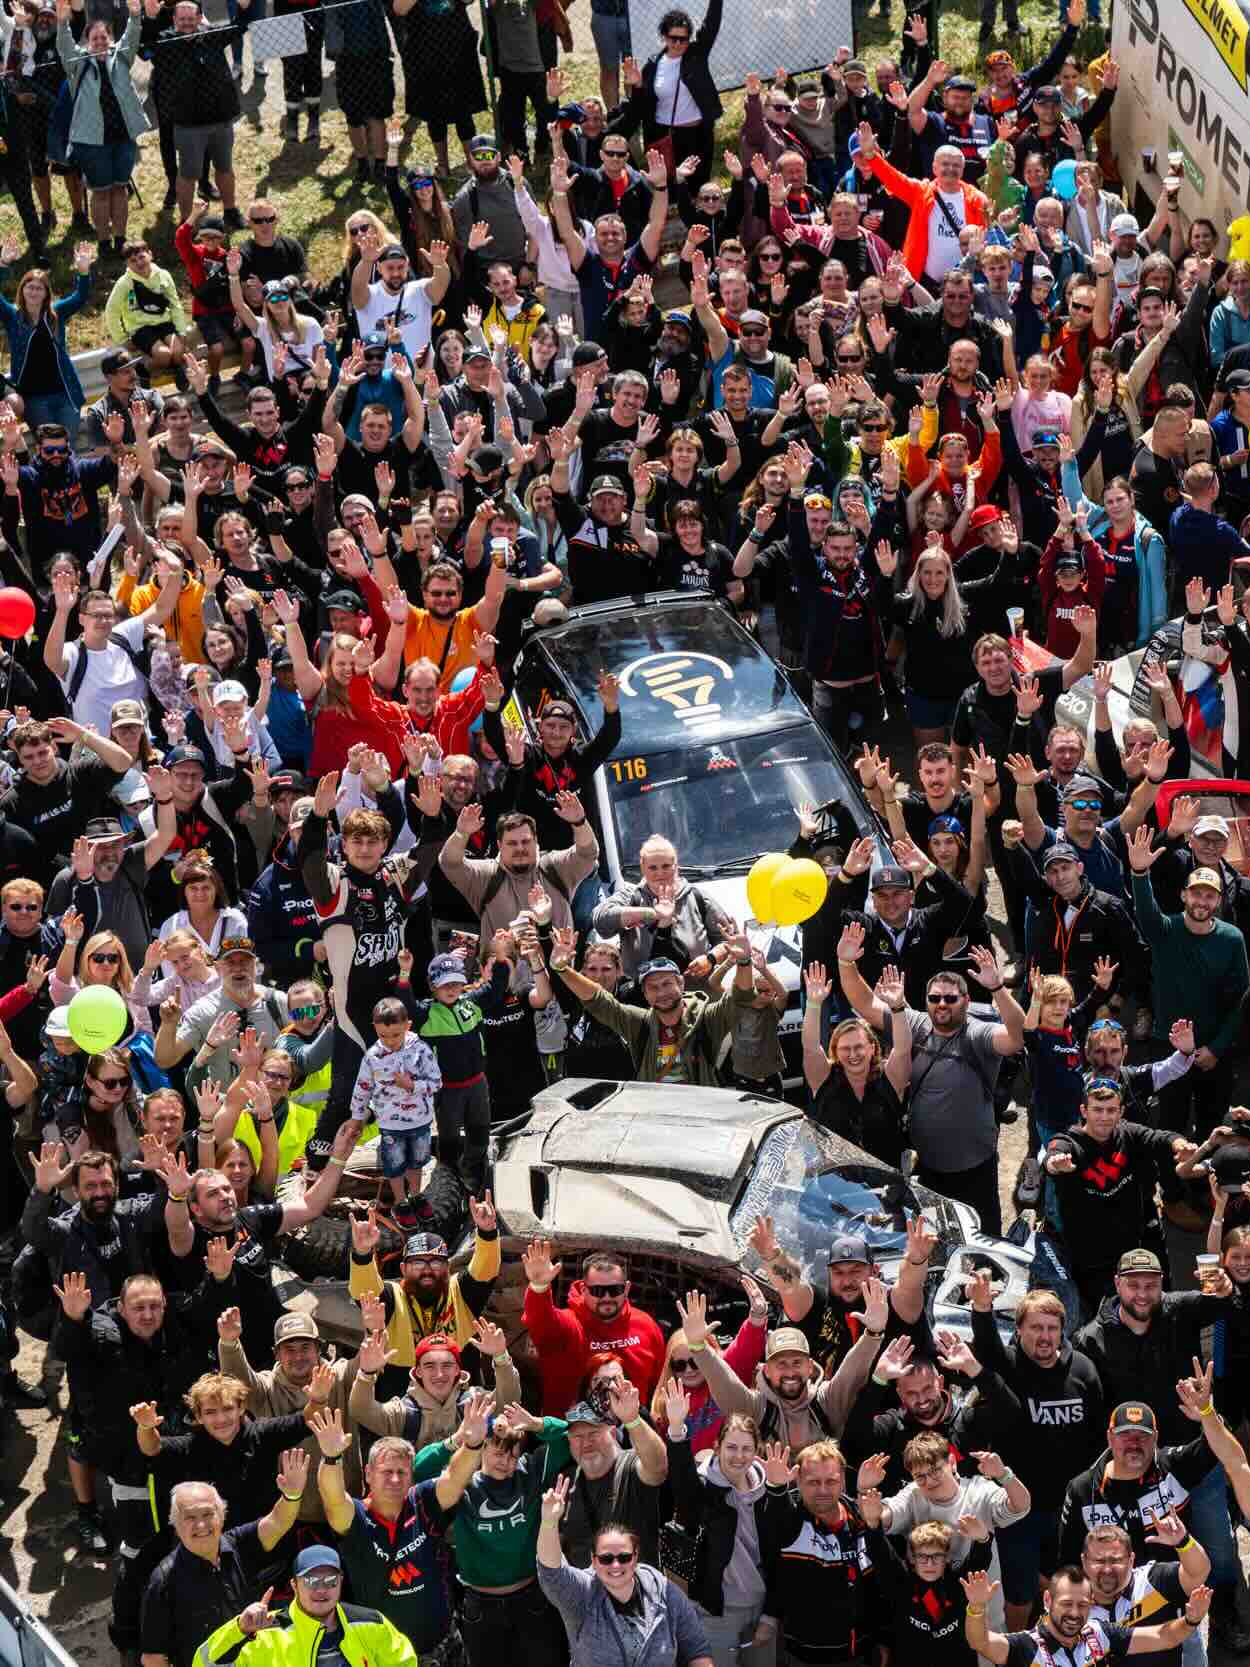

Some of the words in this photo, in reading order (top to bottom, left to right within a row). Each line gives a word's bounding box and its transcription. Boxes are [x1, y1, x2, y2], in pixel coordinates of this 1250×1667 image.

[610, 757, 648, 786] 116
[1028, 1398, 1083, 1424] VANS
[477, 1513, 527, 1532] AIR
[374, 1532, 426, 1562] PROETEON
[908, 1616, 960, 1639] TECLOGY
